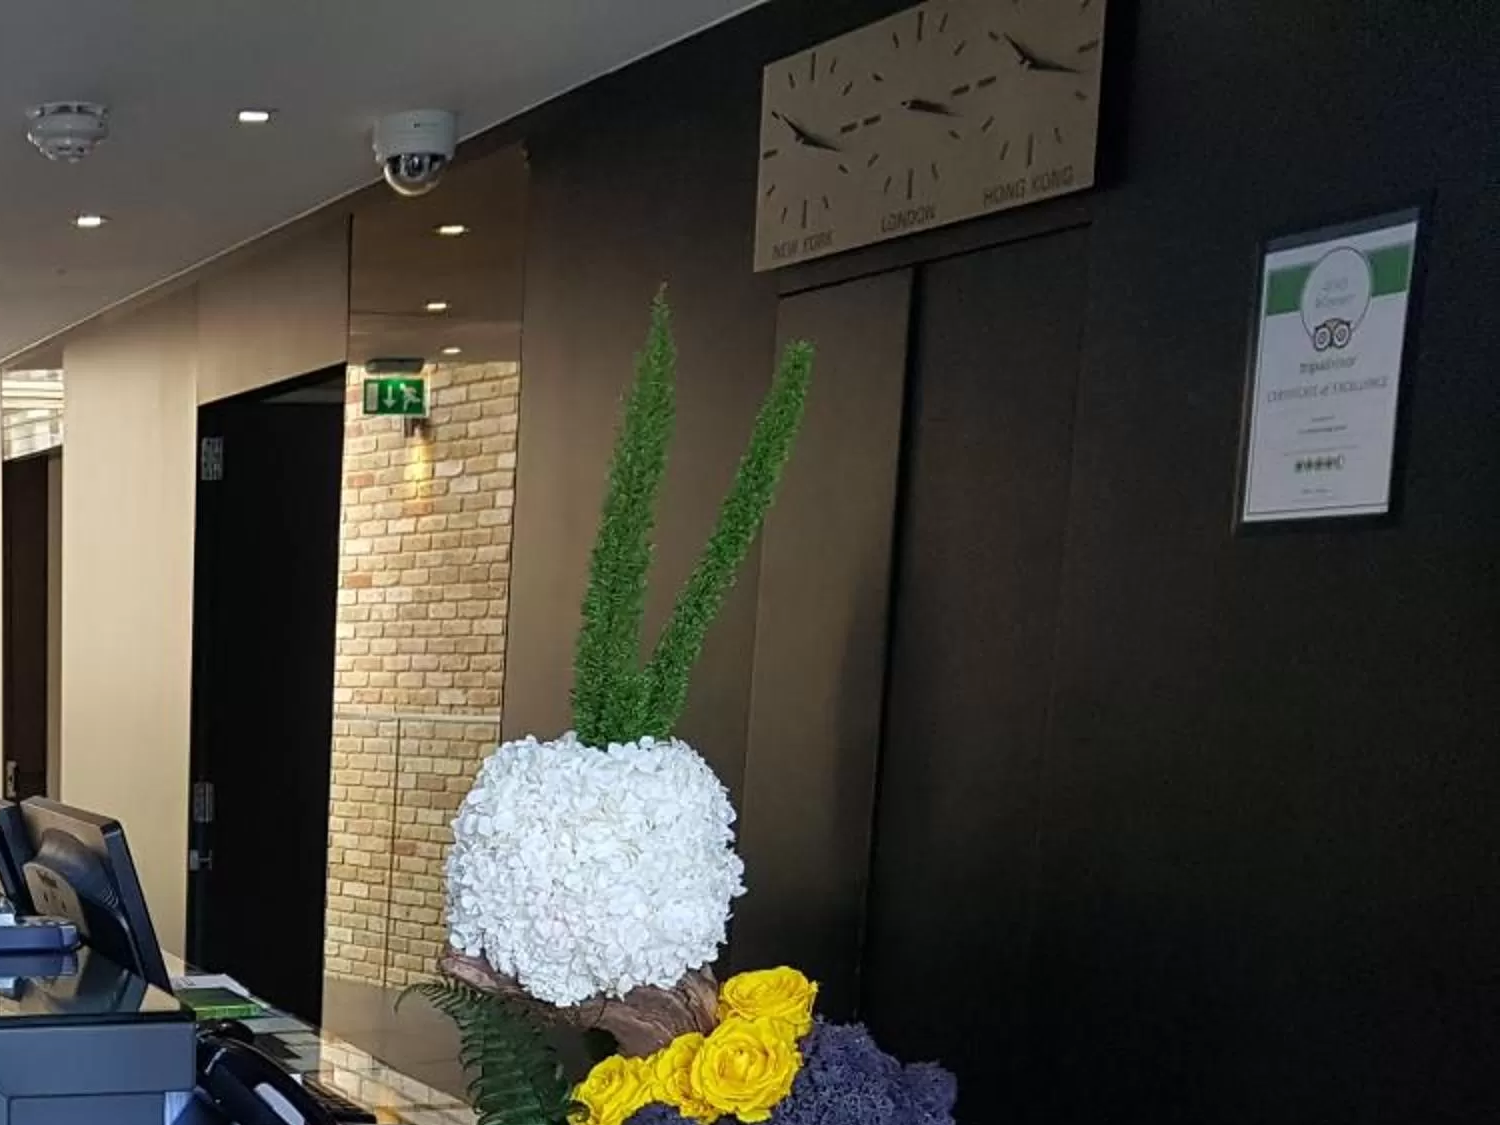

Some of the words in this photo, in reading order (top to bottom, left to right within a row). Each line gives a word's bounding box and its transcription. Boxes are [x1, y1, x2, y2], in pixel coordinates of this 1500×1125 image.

[982, 178, 1026, 207] HONG
[881, 205, 938, 233] LONDON
[772, 241, 798, 261] NEW
